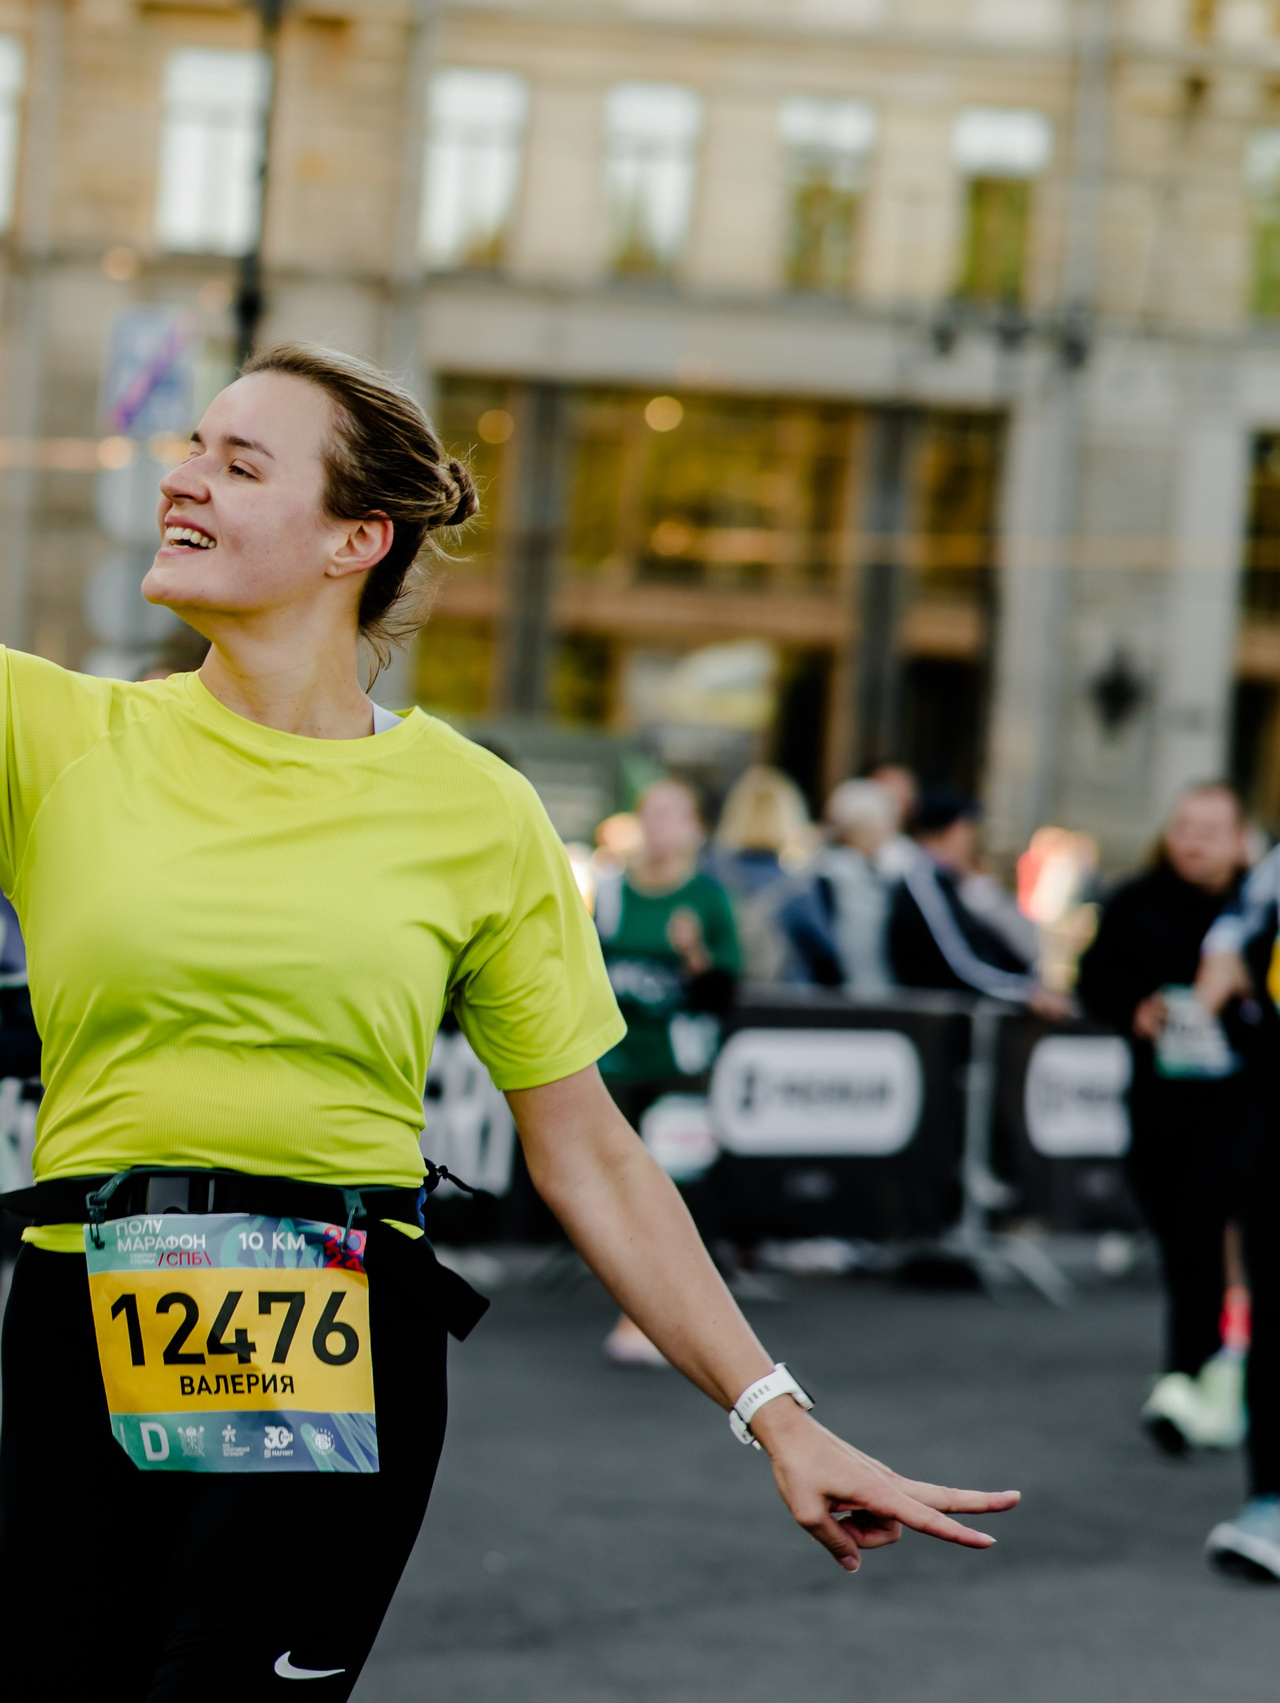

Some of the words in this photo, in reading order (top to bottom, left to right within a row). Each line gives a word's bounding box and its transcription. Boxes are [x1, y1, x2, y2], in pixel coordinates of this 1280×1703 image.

[116, 1219, 163, 1237] ПОЛУ
[117, 1234, 206, 1252] МАРАФОН
[238, 1232, 264, 1250] 10
[272, 1232, 306, 1250] КМ
[110, 1290, 360, 1367] 12476
[179, 1373, 295, 1396] ВАЛЕРИЯ
[140, 1421, 170, 1462] D
